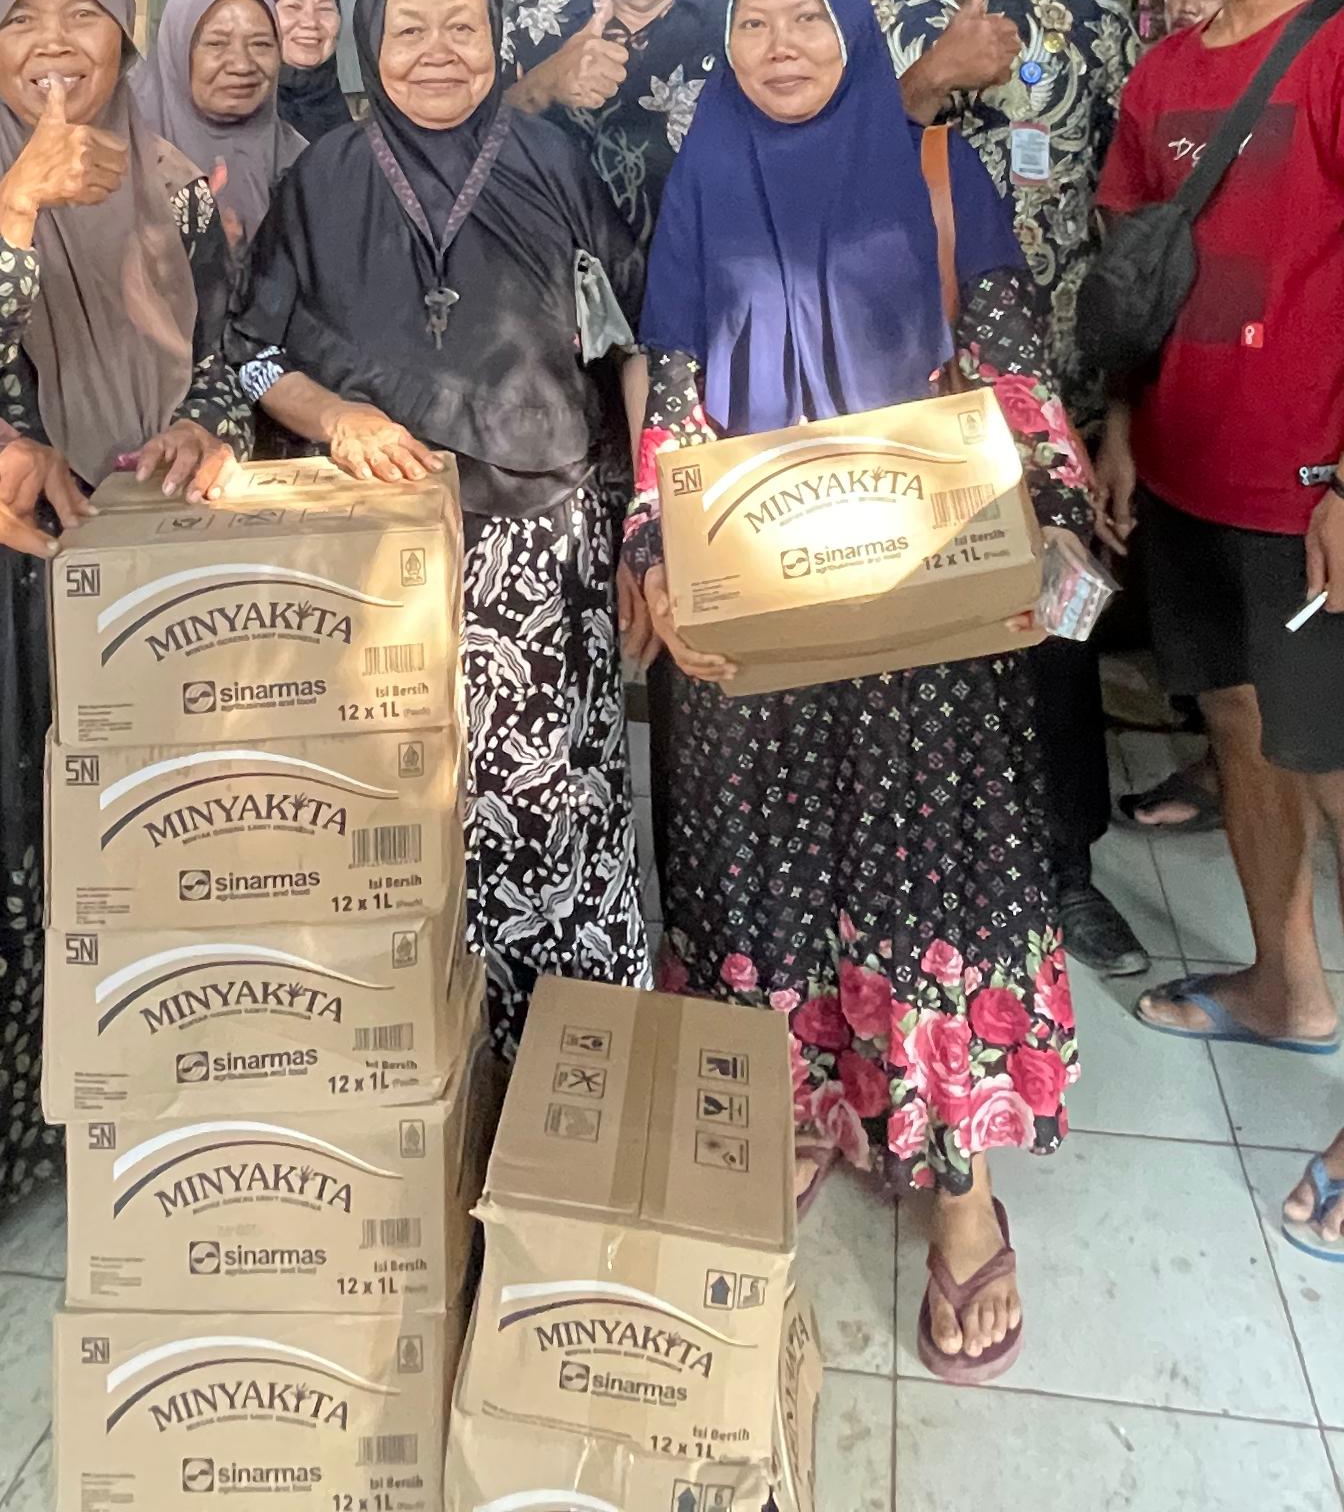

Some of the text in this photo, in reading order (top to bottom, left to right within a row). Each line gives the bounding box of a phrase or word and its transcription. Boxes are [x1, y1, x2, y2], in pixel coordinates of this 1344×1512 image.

[743, 465, 925, 534] MINYAKITA
[814, 536, 909, 565] sinarmas
[922, 554, 942, 571] 12
[960, 546, 982, 564] 1L
[66, 564, 101, 598] SNI
[144, 600, 352, 662] MINYAKITA
[220, 679, 327, 703] sinarmas
[393, 683, 430, 696] Bersih
[337, 704, 360, 722] 12
[379, 702, 400, 718] 1L
[66, 754, 100, 786] SNI
[142, 792, 347, 848] MINYAKITA
[214, 870, 321, 892] sinarmas
[386, 874, 422, 887] Bersih
[331, 896, 353, 912] 12
[373, 893, 393, 909] 1L
[66, 932, 98, 966] SNI
[140, 980, 343, 1035] MINYAKITA
[213, 1048, 318, 1072] sinarmas
[328, 1076, 349, 1094] 12
[369, 1073, 389, 1089] 1L
[154, 1163, 352, 1218] MINYAKITA
[224, 1245, 327, 1266] sinarmas
[337, 1278, 358, 1295] 12
[377, 1277, 399, 1295] 1L
[534, 1319, 713, 1379] MINYAKITA
[592, 1372, 688, 1401] sinarmas
[148, 1380, 348, 1432] MINYAKITA
[649, 1434, 673, 1454] 12
[695, 1442, 716, 1460] 1L
[218, 1463, 322, 1484] sinarmas
[332, 1494, 354, 1512] 12
[373, 1494, 393, 1512] 1L
